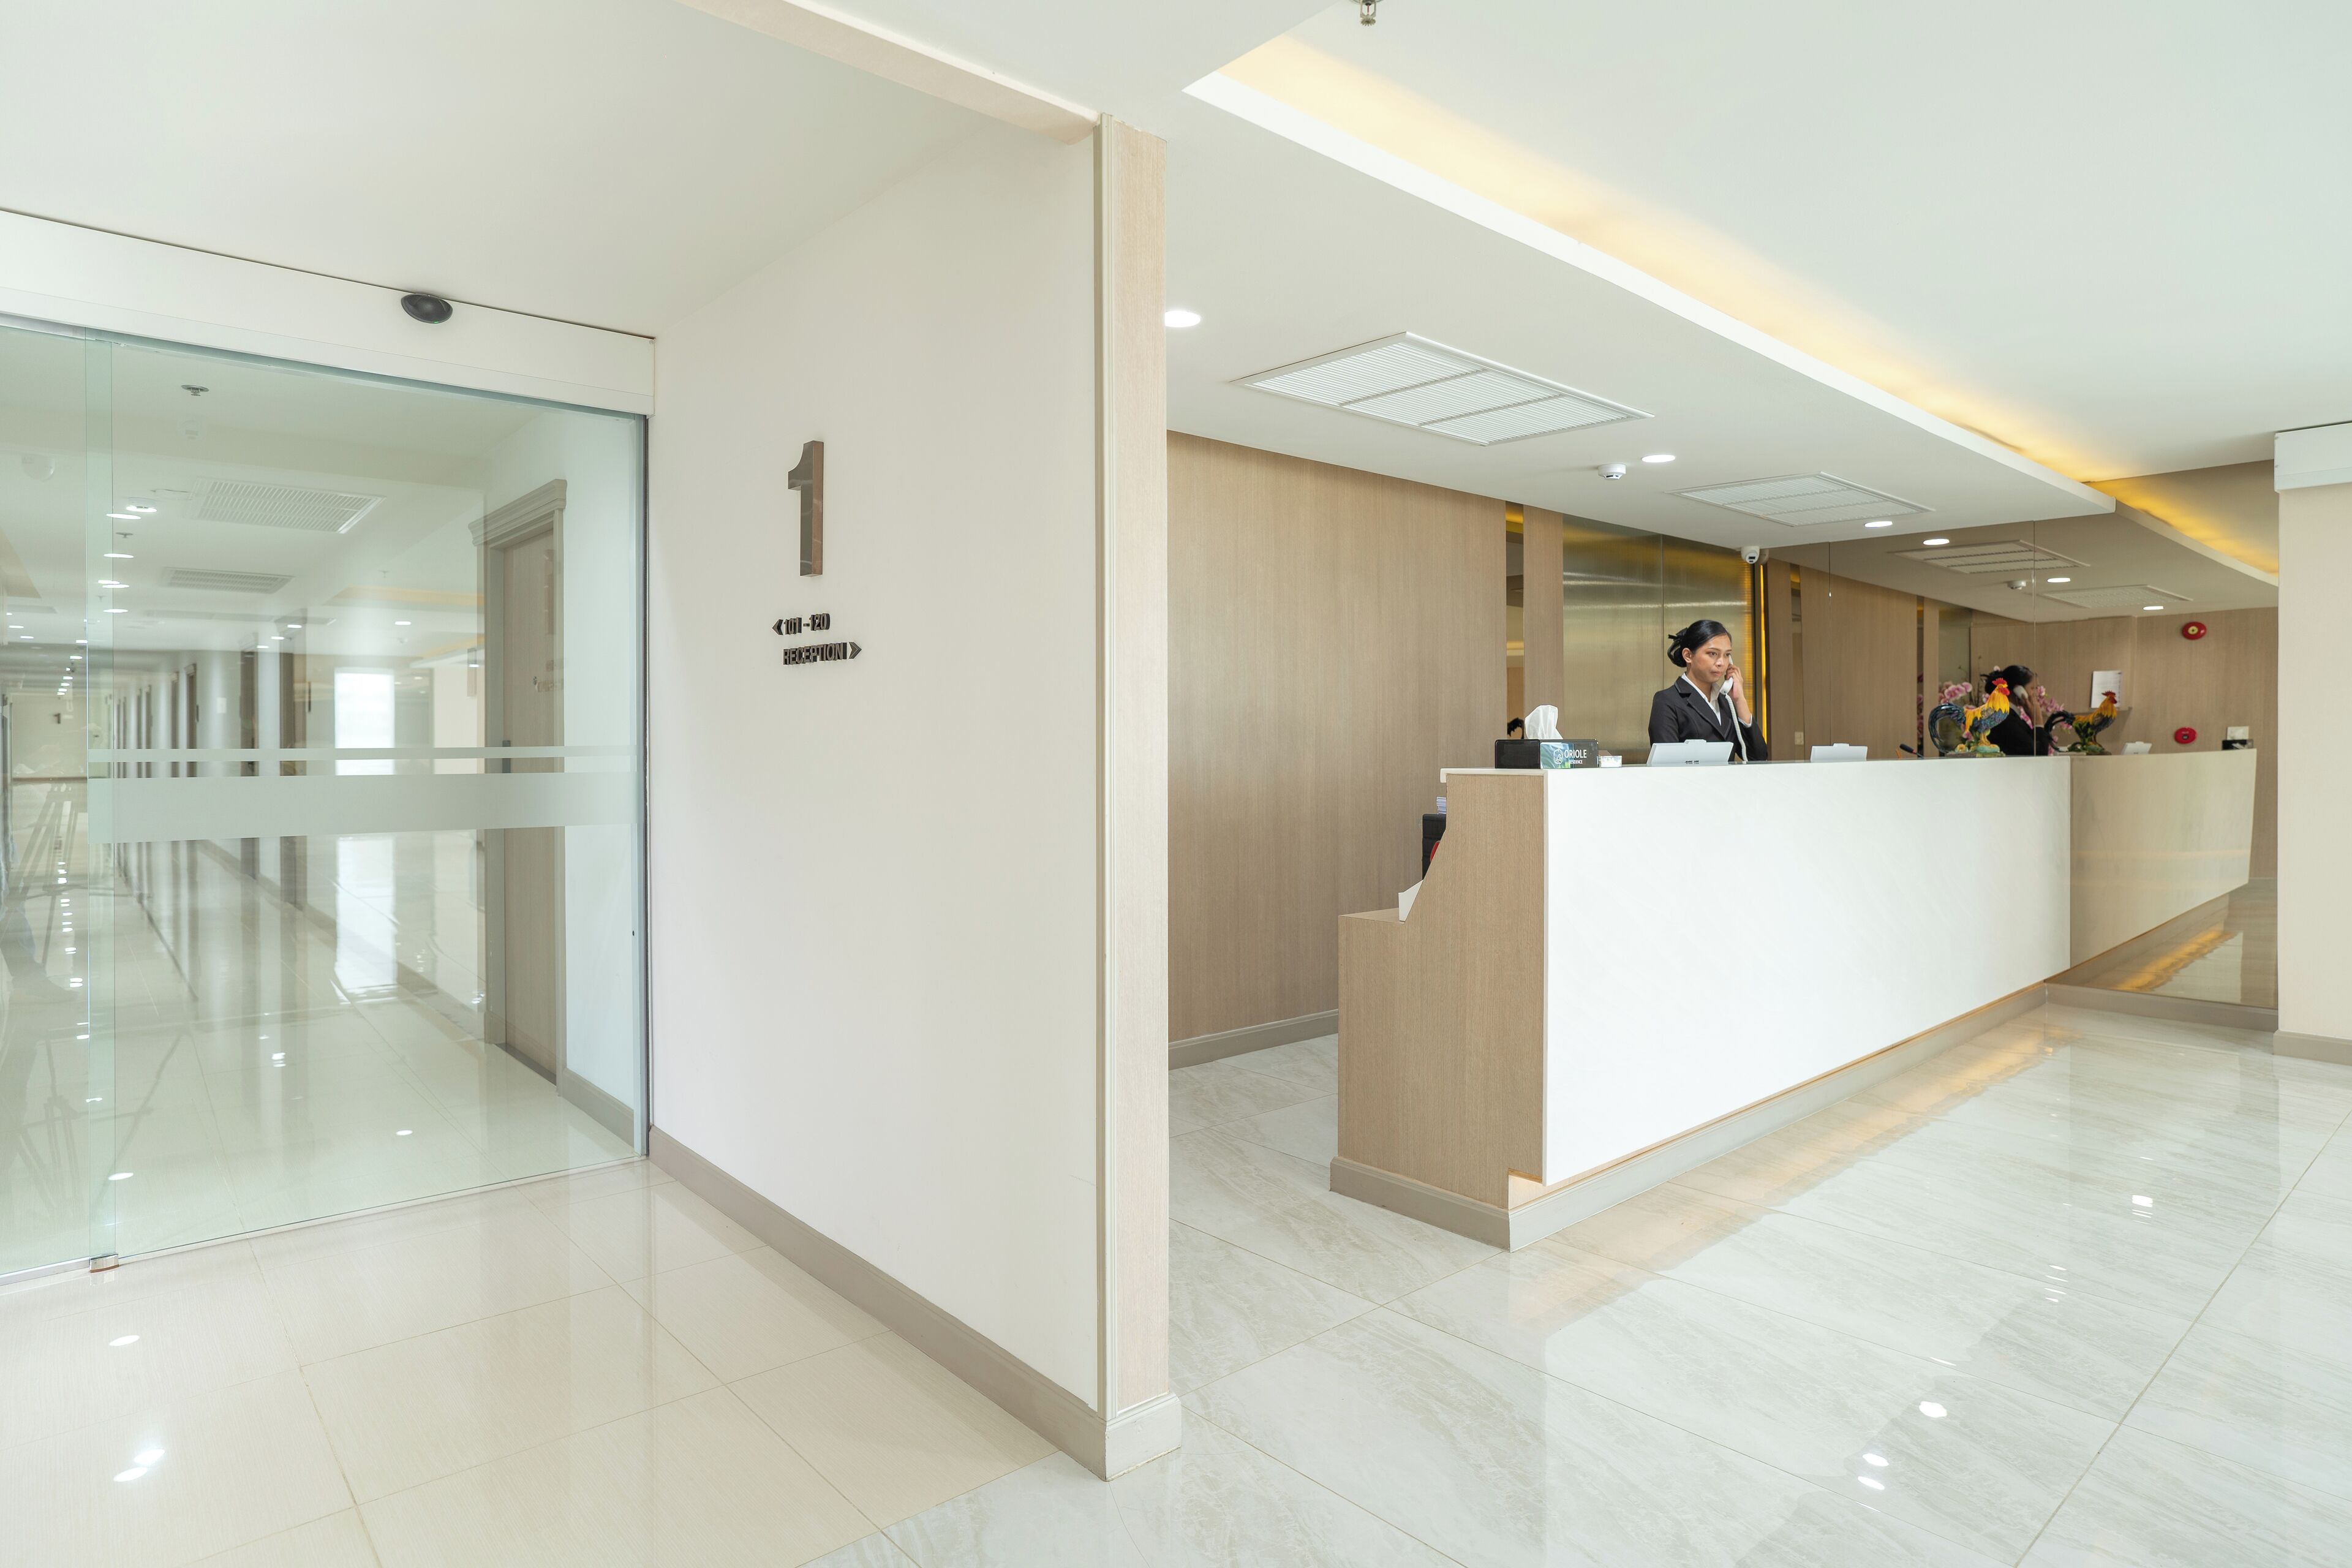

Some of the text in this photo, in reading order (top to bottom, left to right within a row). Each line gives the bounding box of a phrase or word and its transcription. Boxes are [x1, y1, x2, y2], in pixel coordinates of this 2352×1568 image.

[788, 440, 824, 577] 1
[783, 642, 847, 665] RECEPTION
[1564, 749, 1587, 758] ORIOLE
